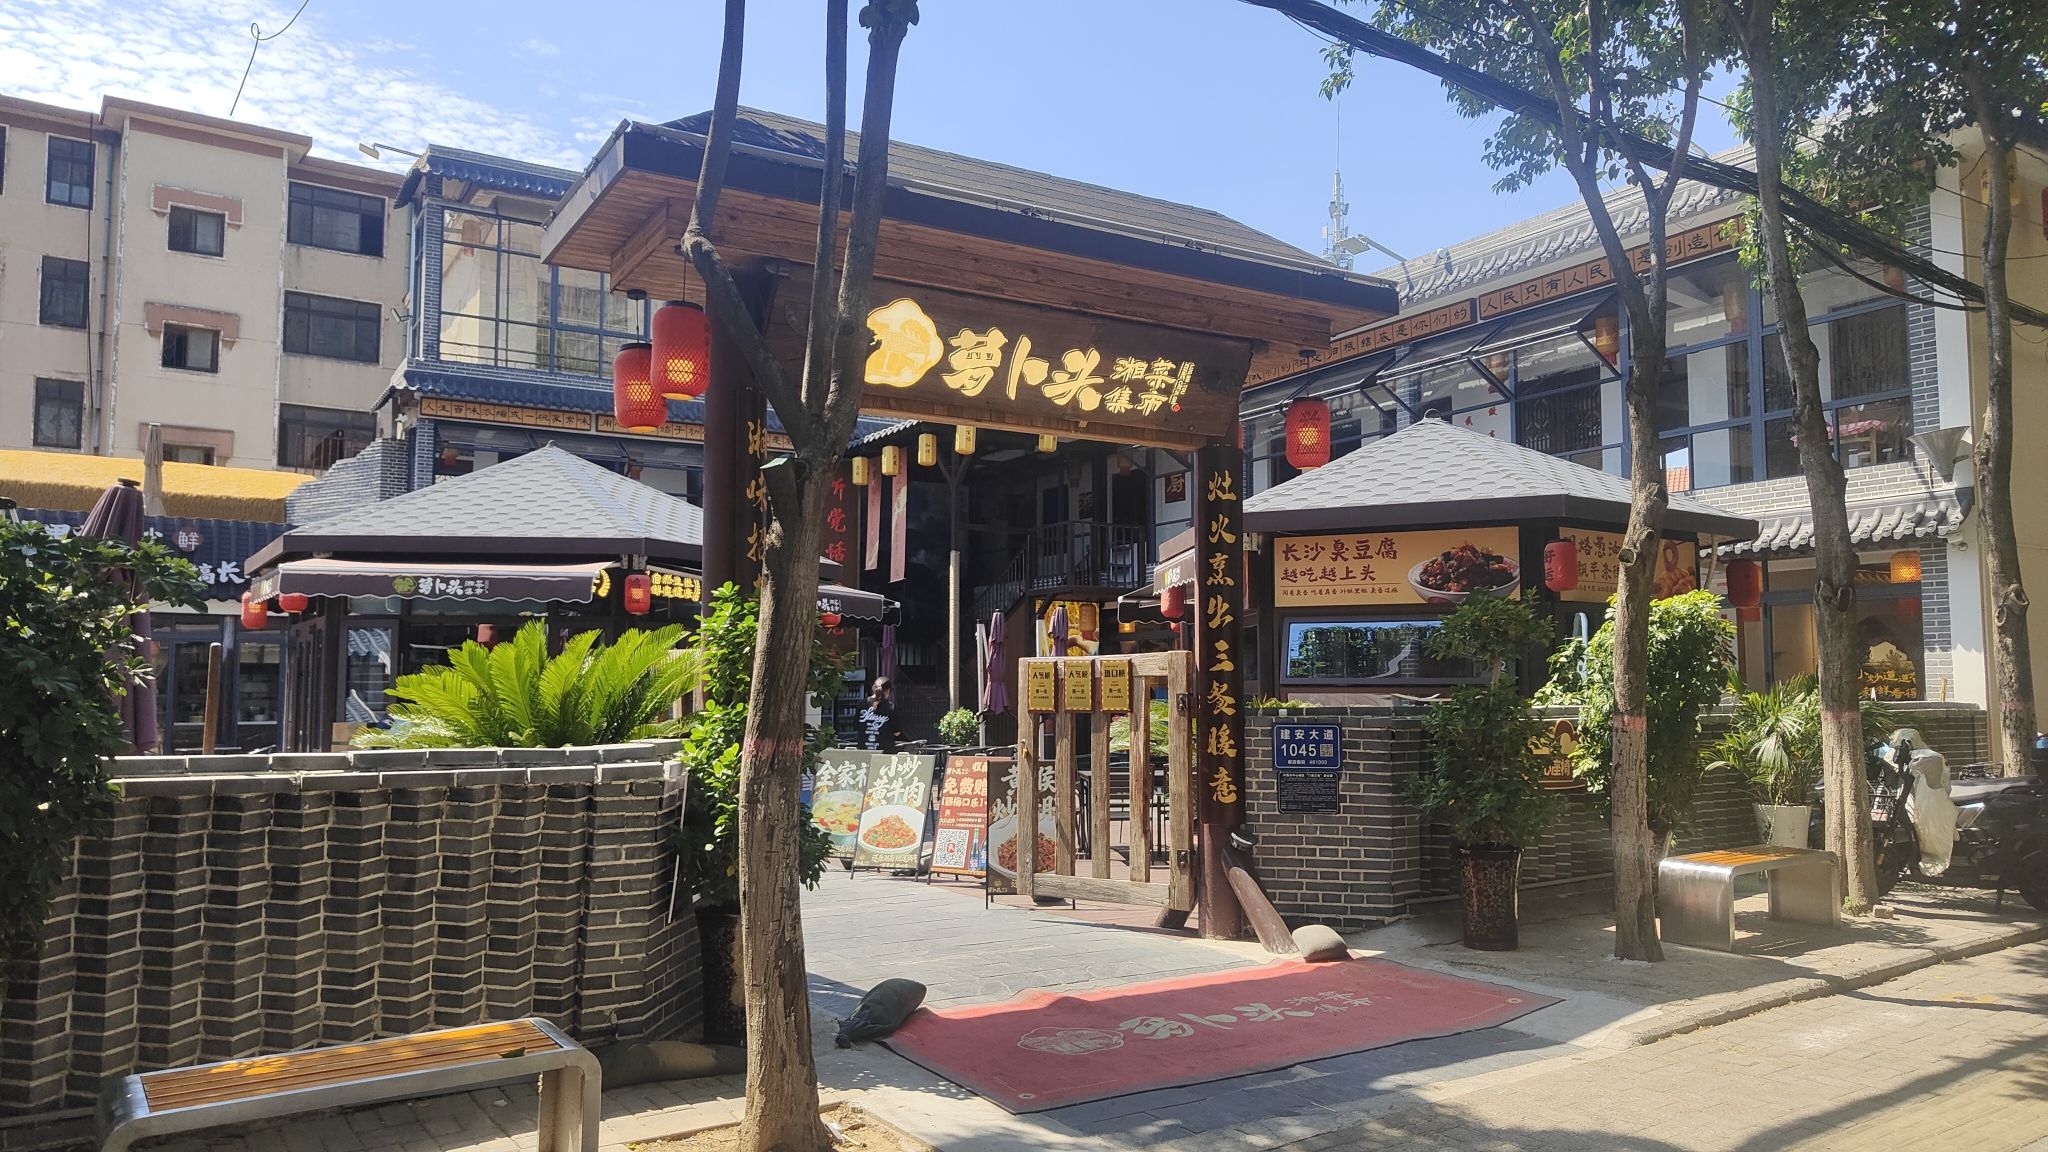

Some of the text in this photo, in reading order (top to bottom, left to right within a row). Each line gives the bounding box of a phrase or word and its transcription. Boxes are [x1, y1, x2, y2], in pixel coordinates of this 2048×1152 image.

[941, 326, 1102, 412] 萝卜头
[1109, 356, 1177, 390] 湘菜
[1102, 385, 1169, 416] 集市
[1167, 473, 1185, 493] 厨
[177, 530, 200, 552] 鲜
[1282, 536, 1398, 562] 长沙臭豆腐
[418, 576, 464, 596] 萝卜头
[1280, 564, 1377, 583] 越吃越上头
[1206, 469, 1237, 804] 灶火烹出三餐暖意
[1280, 728, 1334, 741] 建安大道
[1280, 743, 1317, 757] 1045
[879, 754, 922, 780] 小炒
[868, 775, 926, 808] 黄牛肉
[1117, 1002, 1316, 1040] 萝卜头
